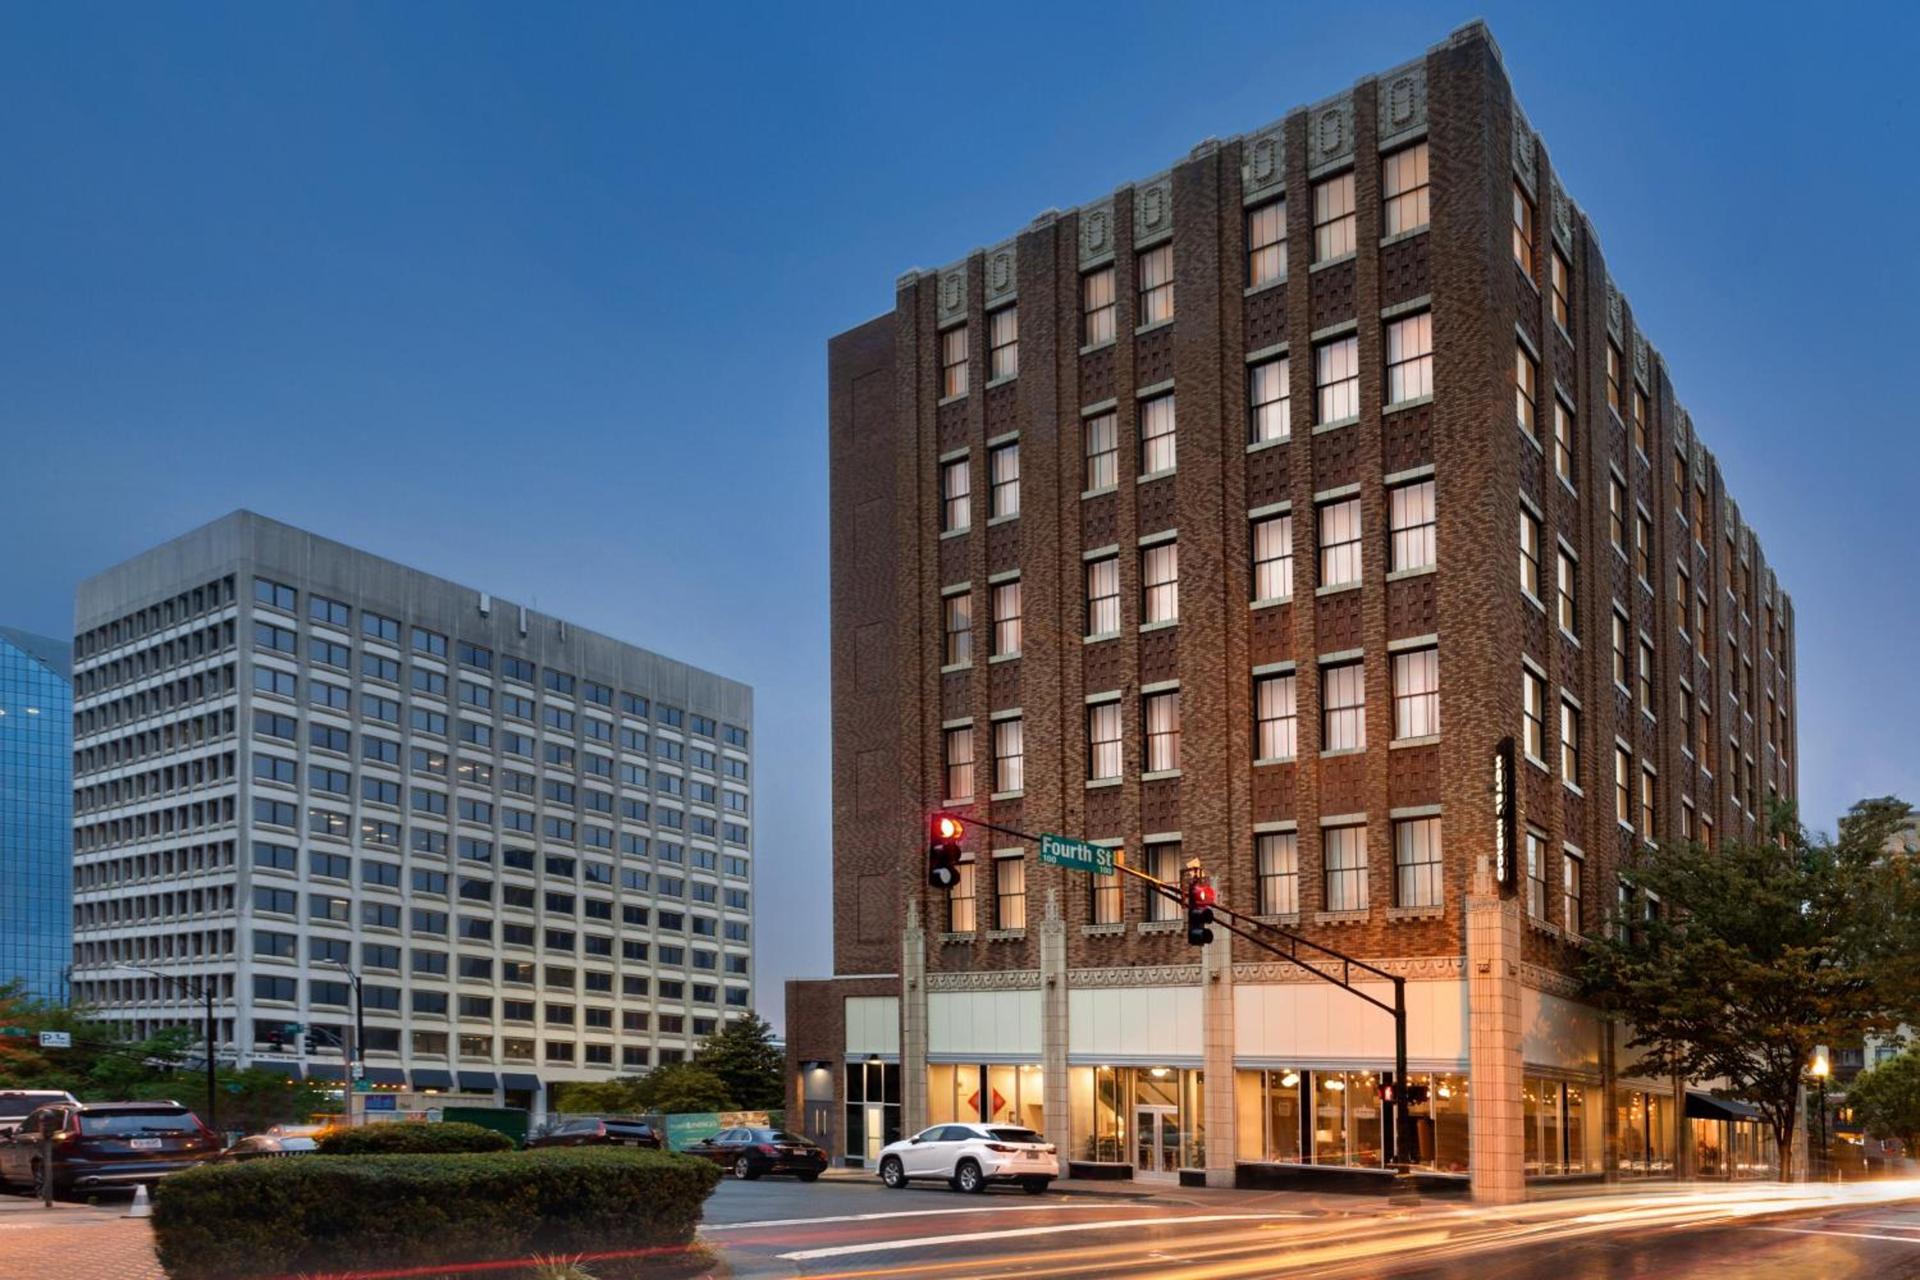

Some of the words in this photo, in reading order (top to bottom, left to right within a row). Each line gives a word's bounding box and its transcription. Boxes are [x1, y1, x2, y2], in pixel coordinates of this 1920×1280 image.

[1042, 836, 1092, 862] Fourth
[1097, 849, 1112, 867] St
[1043, 854, 1057, 864] 100
